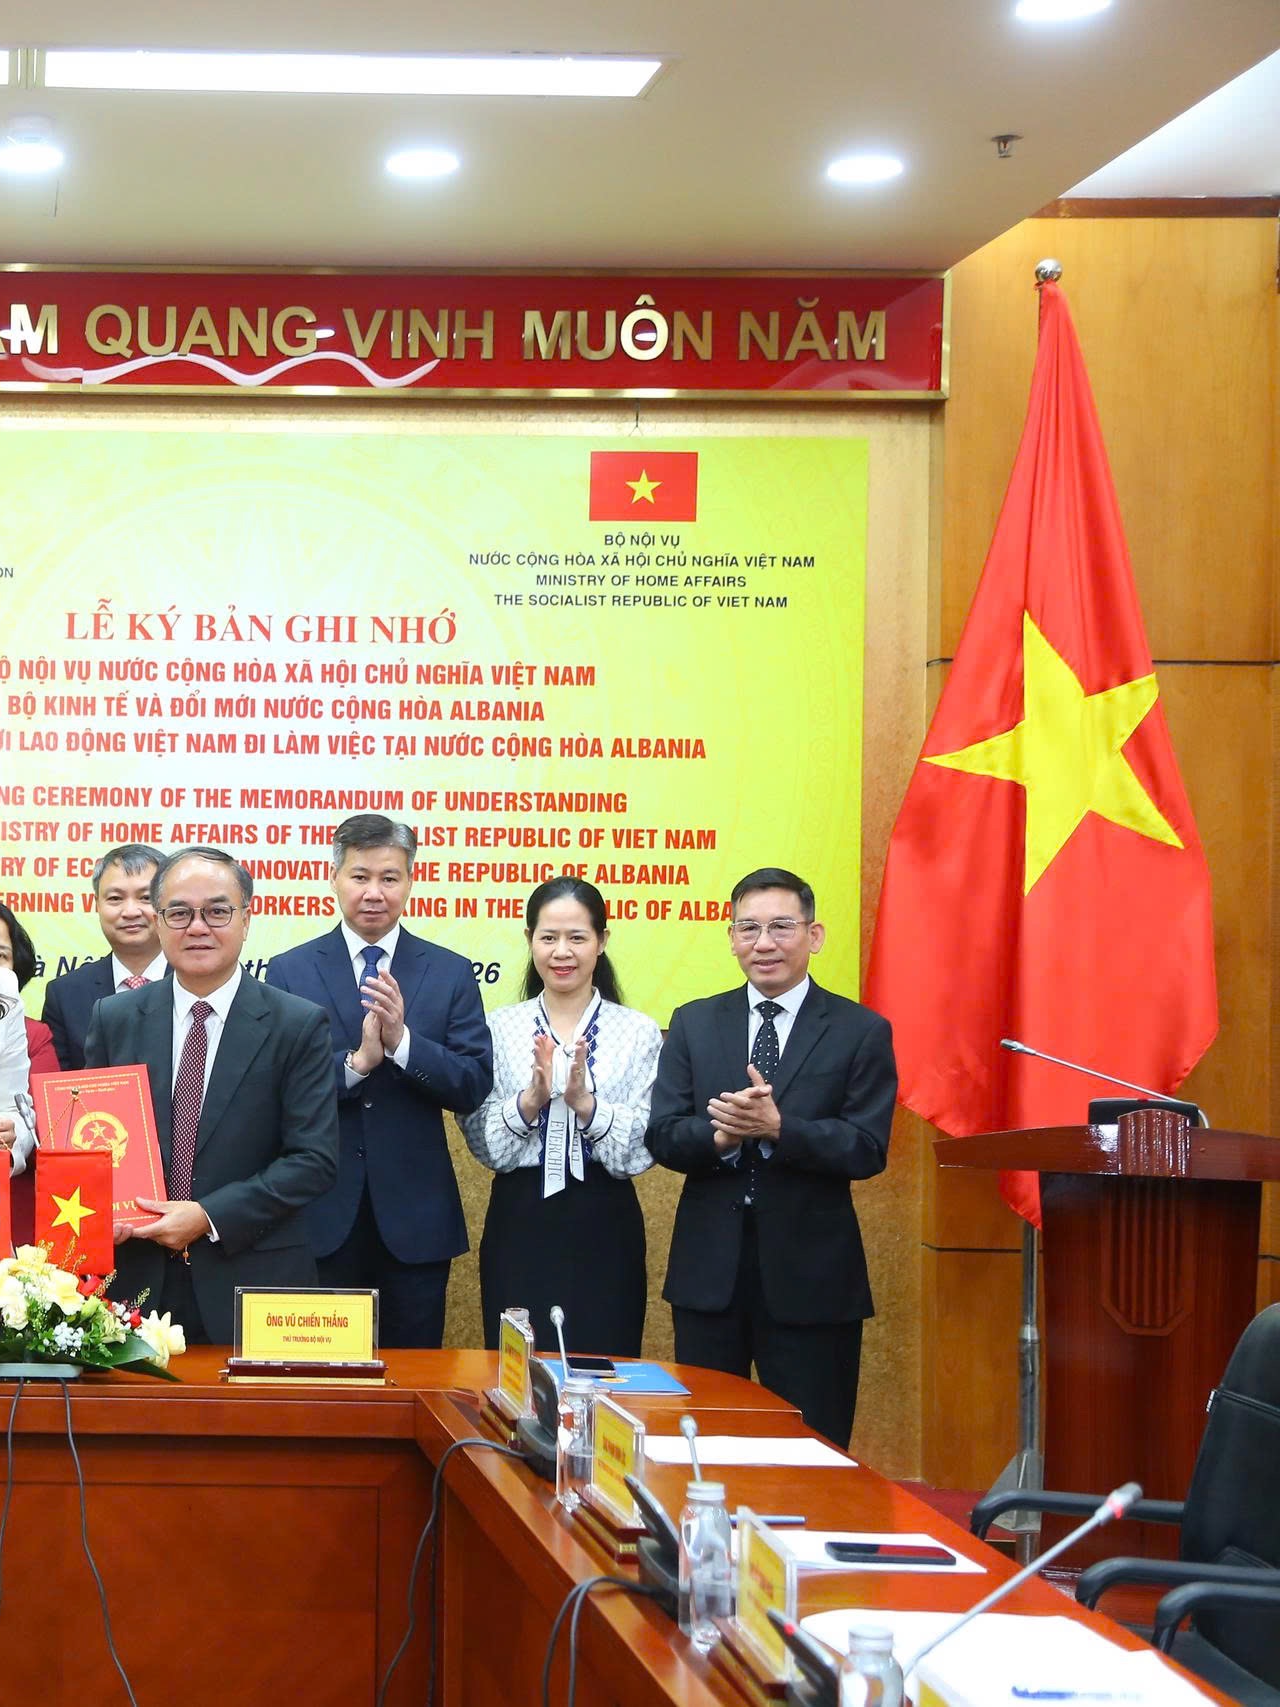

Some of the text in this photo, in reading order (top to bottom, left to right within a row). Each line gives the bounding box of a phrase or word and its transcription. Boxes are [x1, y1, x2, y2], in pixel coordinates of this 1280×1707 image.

[85, 302, 319, 358] QUANG
[342, 305, 494, 361] VINH
[524, 295, 714, 361] MUÔN
[738, 296, 886, 362] NĂM
[604, 532, 680, 549] BỘ NỘI VỤ
[470, 551, 814, 569] NƯỚC CỘNG HÒA XÃ HỘI CHỦ NGHĨA VIỆT NAM
[537, 575, 746, 587] MINISTRY OF HOME AFFAIRS
[494, 594, 787, 608] THE SOCIALIST REPUBLIC OF VIET NAM
[67, 599, 456, 644] LỄ KÝ BẢN GHI NHỚ
[19, 656, 55, 684] NỘI
[64, 660, 90, 685] VỤ
[99, 657, 158, 681] NƯỚC
[166, 658, 225, 686] CỘNG
[234, 658, 277, 683] HÒA
[285, 659, 313, 683] XÃ
[321, 659, 356, 688] HỘI
[365, 657, 408, 684] CHỦ
[416, 661, 483, 685] NGHĨA
[491, 661, 537, 690] VIỆT
[544, 666, 595, 686] NAM
[8, 691, 36, 719] BỘ
[44, 696, 96, 716] KINH
[104, 690, 128, 716] TẾ
[136, 693, 163, 717] VÀ
[170, 690, 206, 717] ĐỔI
[214, 694, 256, 718] MỚI
[264, 695, 323, 719] NƯỚC
[332, 695, 391, 724] CỘNG
[399, 695, 442, 720] HÒA
[450, 701, 544, 721] ALBANIA
[20, 731, 58, 751] LAO
[66, 728, 125, 756] ĐỘNG
[134, 729, 179, 757] VIỆT
[186, 733, 236, 753] NAM
[244, 734, 265, 754] ĐI
[273, 730, 319, 754] LÀM
[328, 731, 375, 759] VIỆC
[383, 736, 416, 760] TẠI
[424, 732, 484, 757] NƯỚC
[492, 733, 552, 762] CỘNG
[560, 733, 603, 758] HÒA
[611, 738, 706, 759] ALBANIA
[33, 786, 152, 807] CEREMONY
[161, 788, 186, 808] OF
[193, 788, 232, 808] THE
[240, 789, 403, 810] MEMORANDUM
[412, 791, 437, 811] OF
[445, 791, 627, 813] UNDERSTANDING
[68, 822, 93, 842] OF
[101, 822, 162, 843] HOME
[170, 824, 258, 844] AFFAIRS
[266, 824, 292, 845] OF
[465, 827, 571, 848] REPUBLIC
[579, 828, 605, 848] OF
[612, 828, 658, 849] VIET
[665, 829, 716, 850] NAM
[34, 857, 59, 877] OF
[412, 862, 440, 882] HE
[448, 862, 554, 883] REPUBLIC
[562, 863, 588, 881] OF
[595, 864, 690, 884] ALBANIA
[250, 895, 335, 917] ORKERS
[455, 897, 477, 917] IN
[485, 898, 523, 918] THE
[646, 900, 672, 920] OF
[679, 901, 732, 921] ALBA
[472, 961, 501, 984] 26
[267, 1310, 348, 1327] ÔNG VŨ CHIẾN THẮNG
